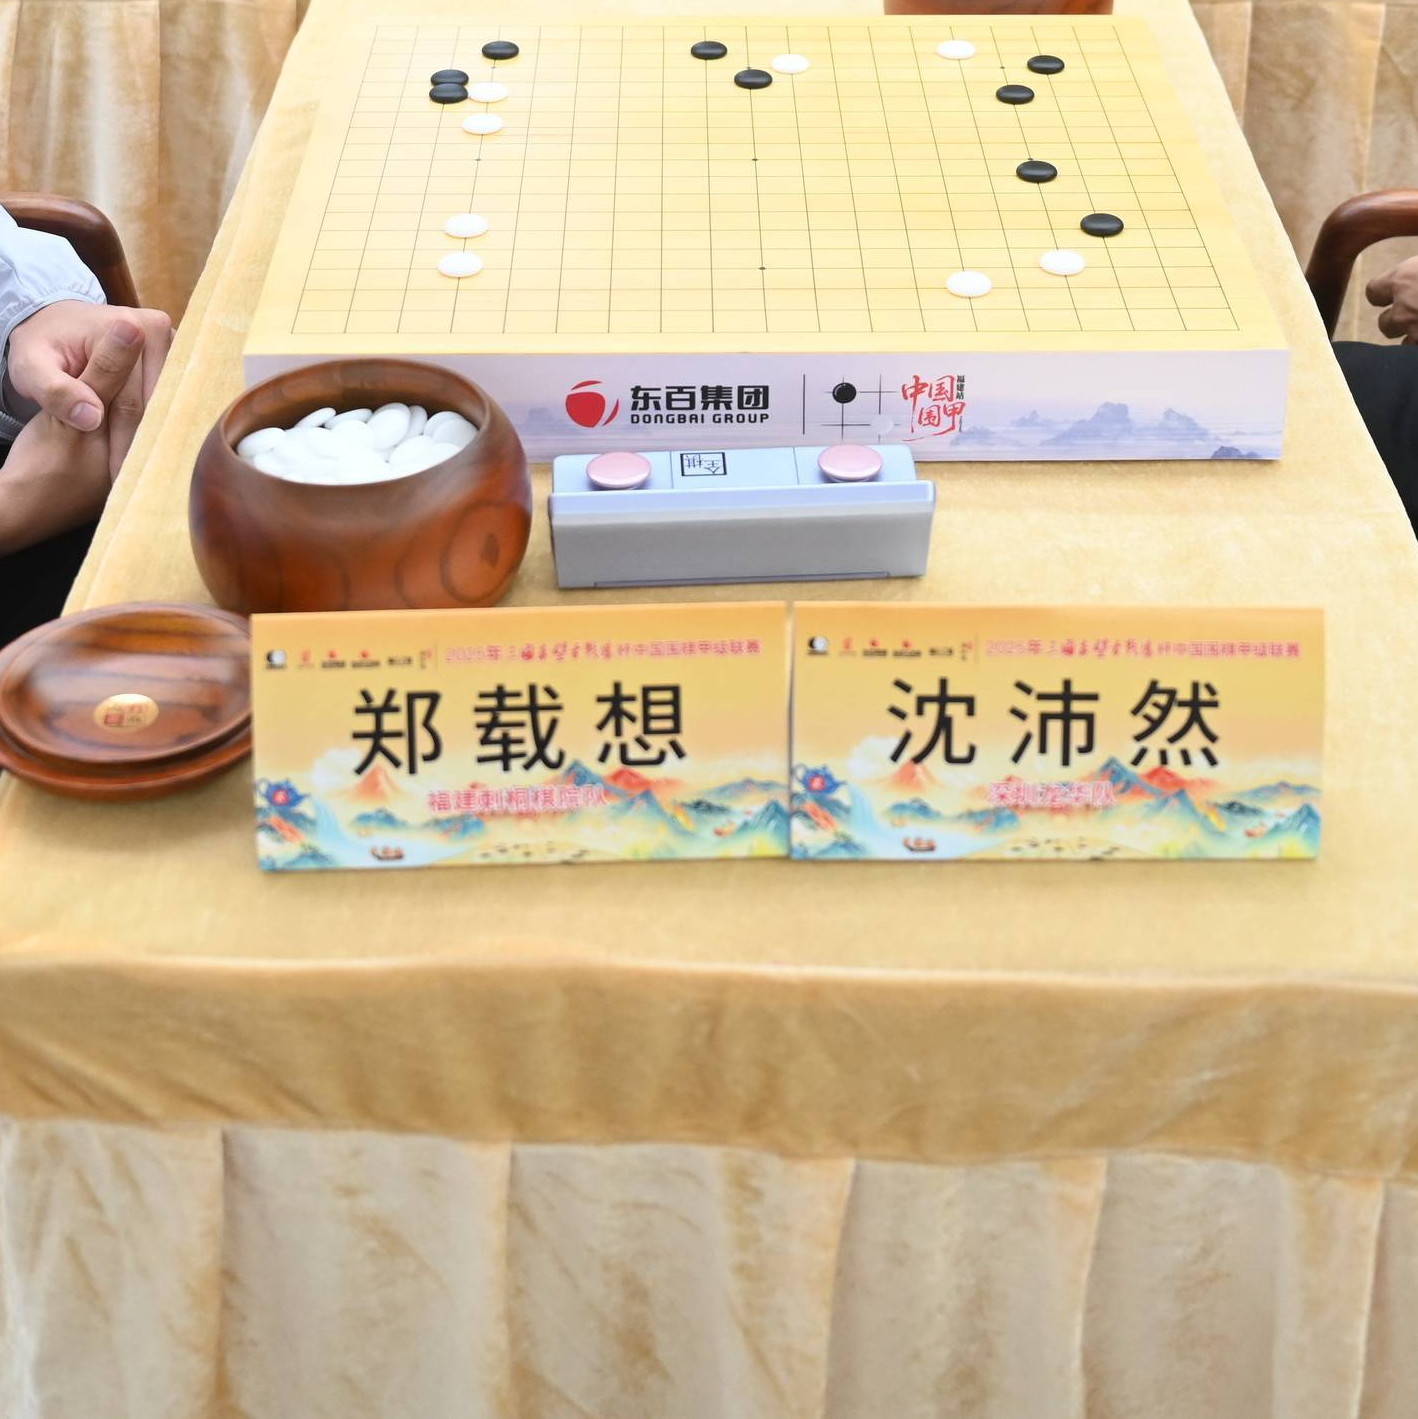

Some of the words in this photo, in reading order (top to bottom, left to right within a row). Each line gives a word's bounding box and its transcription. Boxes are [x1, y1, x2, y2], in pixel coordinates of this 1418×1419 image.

[631, 385, 769, 411] 东百集团
[631, 413, 705, 424] DONGBAI
[712, 413, 769, 424] GROUP
[352, 681, 686, 775] 郑载想
[887, 677, 1219, 767] 沈沛然
